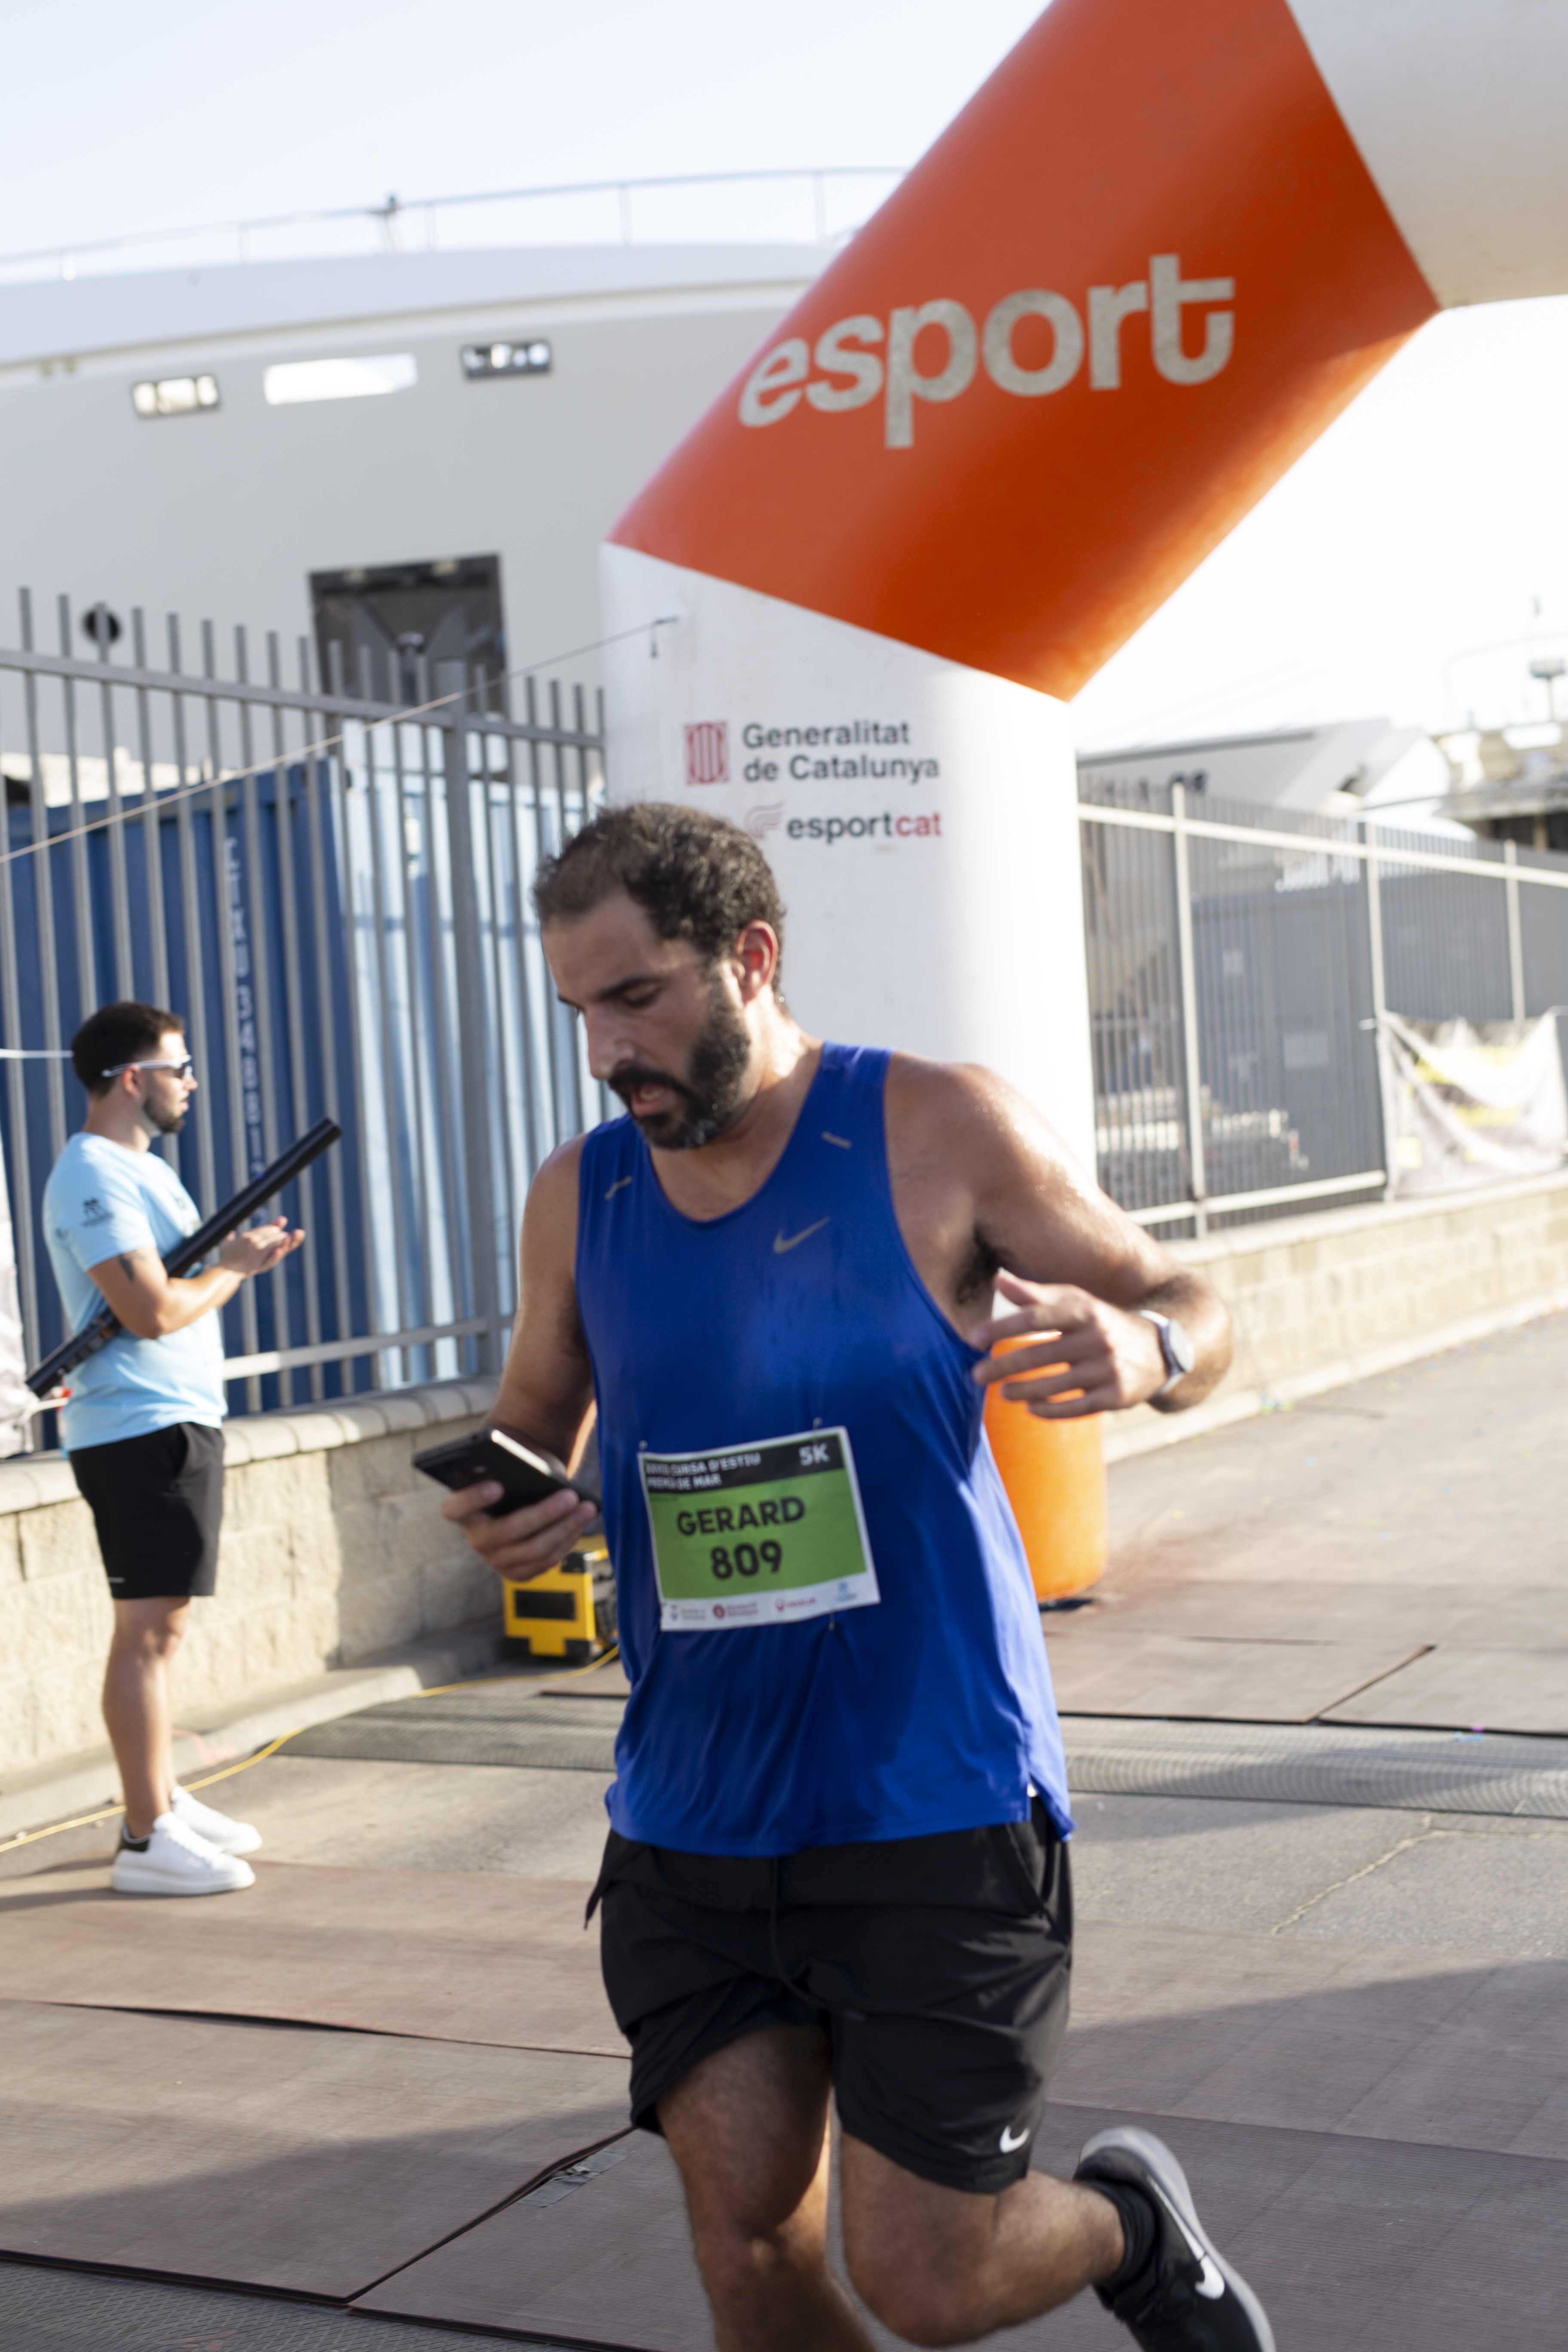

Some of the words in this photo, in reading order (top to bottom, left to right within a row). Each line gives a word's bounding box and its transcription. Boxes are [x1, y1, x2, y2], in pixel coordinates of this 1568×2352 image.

[738, 253, 1235, 448] esport
[741, 720, 910, 748] Generalitat
[743, 757, 778, 782] de
[789, 753, 940, 785] Catalunya
[787, 812, 942, 845] esportcat
[798, 1443, 830, 1466] 5K
[692, 1472, 723, 1489] MAR
[677, 1496, 805, 1537] GERARD
[710, 1540, 783, 1580] 809
